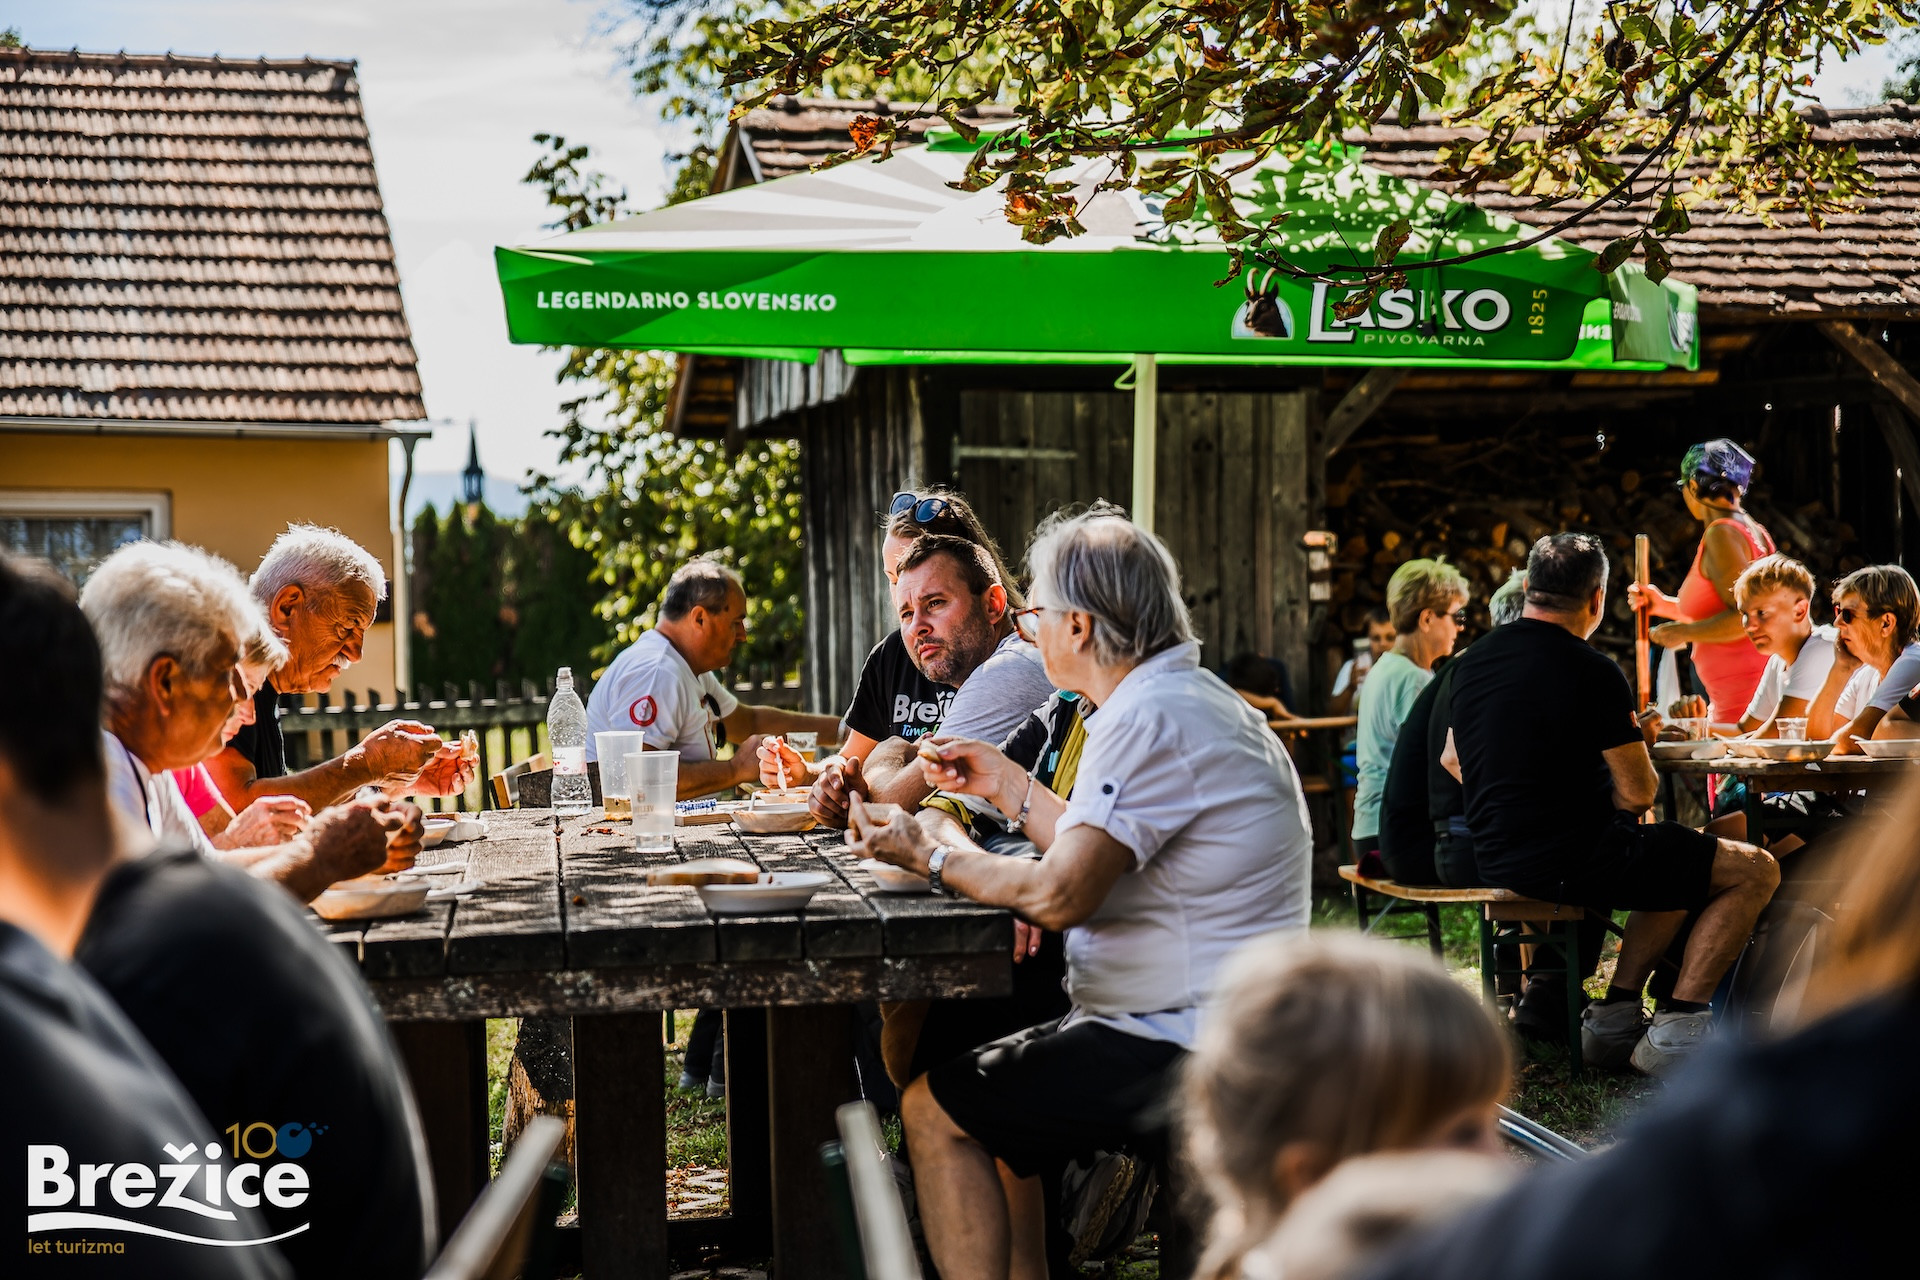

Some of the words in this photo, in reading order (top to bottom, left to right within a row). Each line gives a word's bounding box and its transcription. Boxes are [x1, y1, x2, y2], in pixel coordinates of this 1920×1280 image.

[536, 291, 690, 310] LEGENDARNO
[697, 291, 837, 312] SLOVENSKO
[1527, 289, 1548, 335] 1825
[1363, 333, 1486, 347] PIVOVARNA
